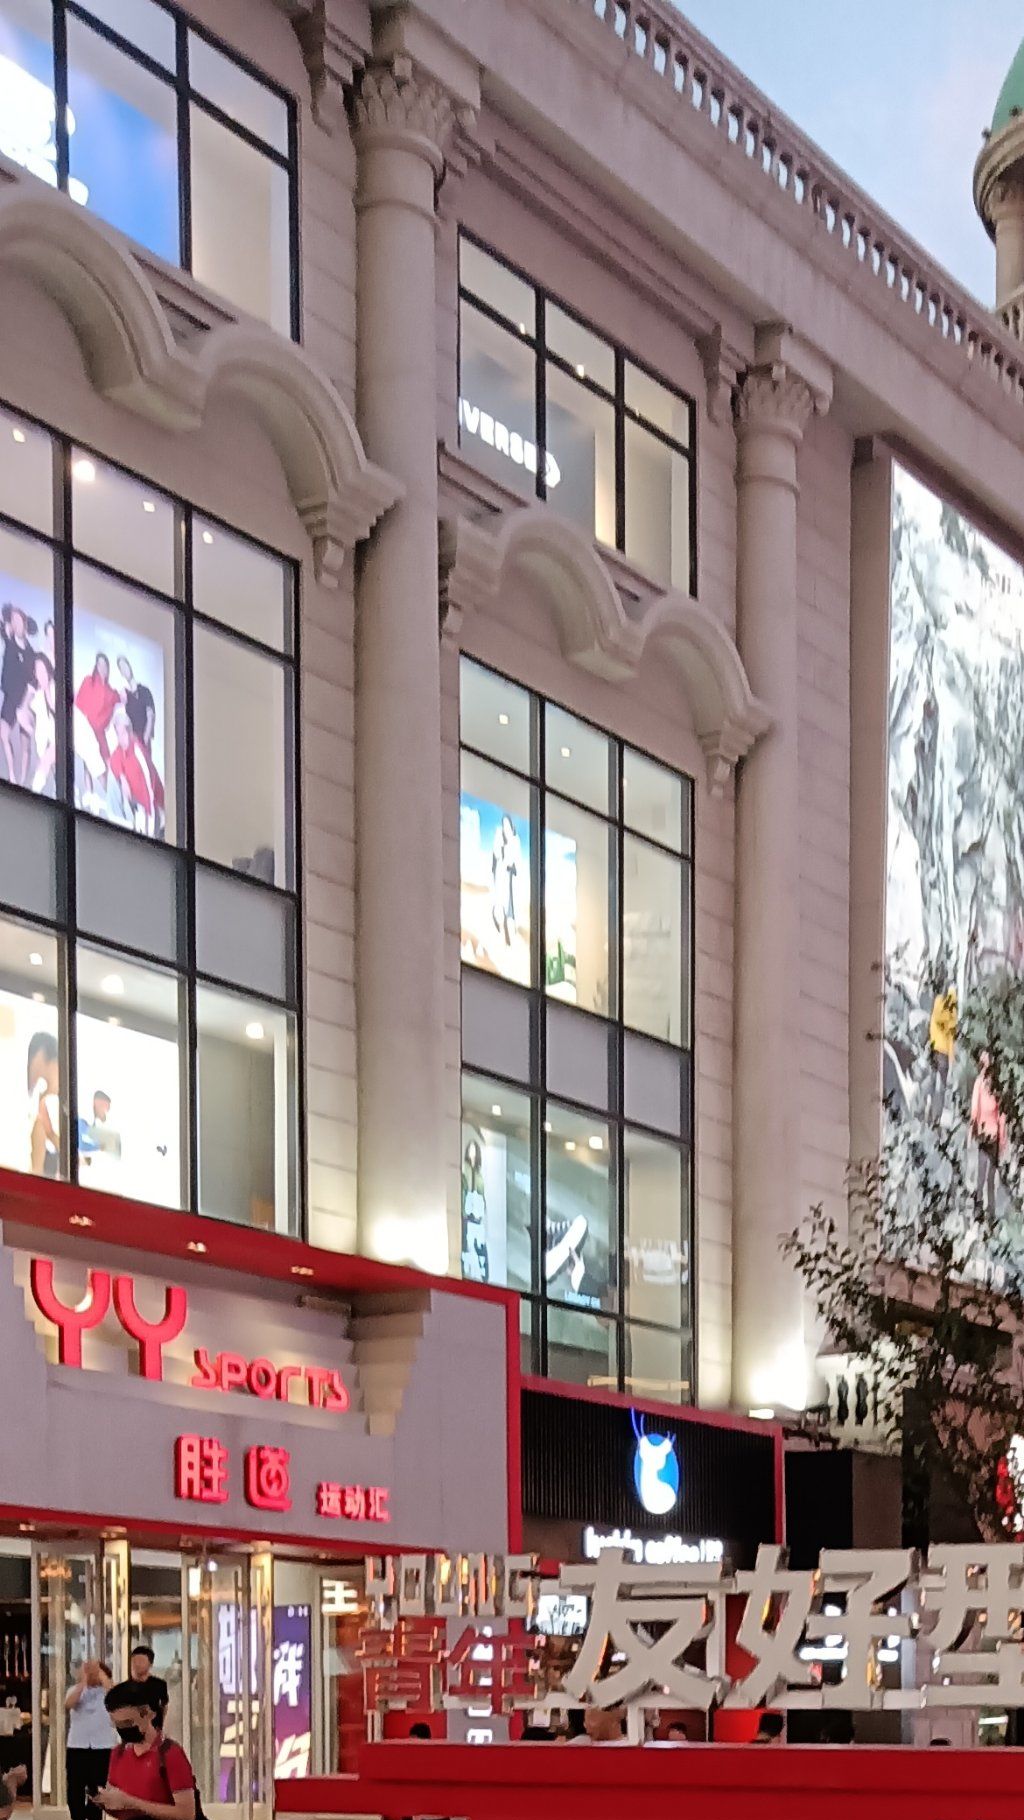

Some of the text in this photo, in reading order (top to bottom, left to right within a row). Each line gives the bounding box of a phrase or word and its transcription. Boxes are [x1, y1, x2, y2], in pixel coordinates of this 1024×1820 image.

[458, 397, 537, 474] VERSE
[30, 1258, 350, 1413] YY SPORTS
[316, 1481, 391, 1523] 运动汇
